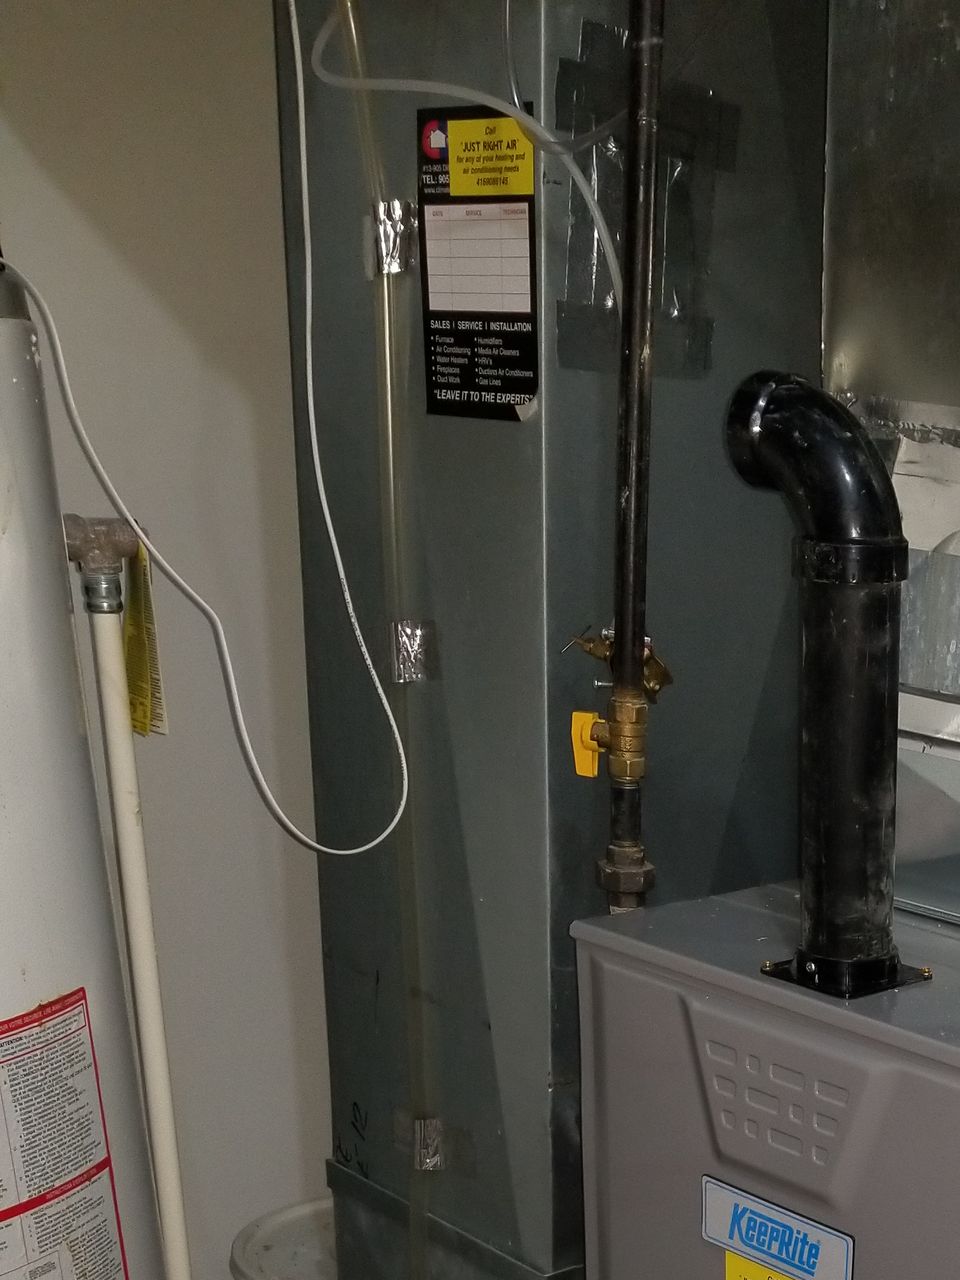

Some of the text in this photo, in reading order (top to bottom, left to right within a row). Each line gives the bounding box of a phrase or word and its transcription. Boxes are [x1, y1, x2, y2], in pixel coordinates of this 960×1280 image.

[485, 126, 496, 135] Call
[483, 141, 503, 151] RIGHT
[495, 154, 514, 162] heating
[471, 166, 502, 175] conditioning
[423, 176, 437, 184] TEL:
[430, 320, 531, 331] SALES SERVICE INSTALLATION
[436, 335, 454, 343] Furnace
[478, 337, 502, 345] Humidifiers
[443, 346, 471, 355] Conditioning
[500, 348, 519, 356] Cleaners
[505, 369, 533, 377] Conditioners
[462, 391, 468, 400] IT
[470, 392, 479, 401] TO
[481, 392, 495, 402] THE
